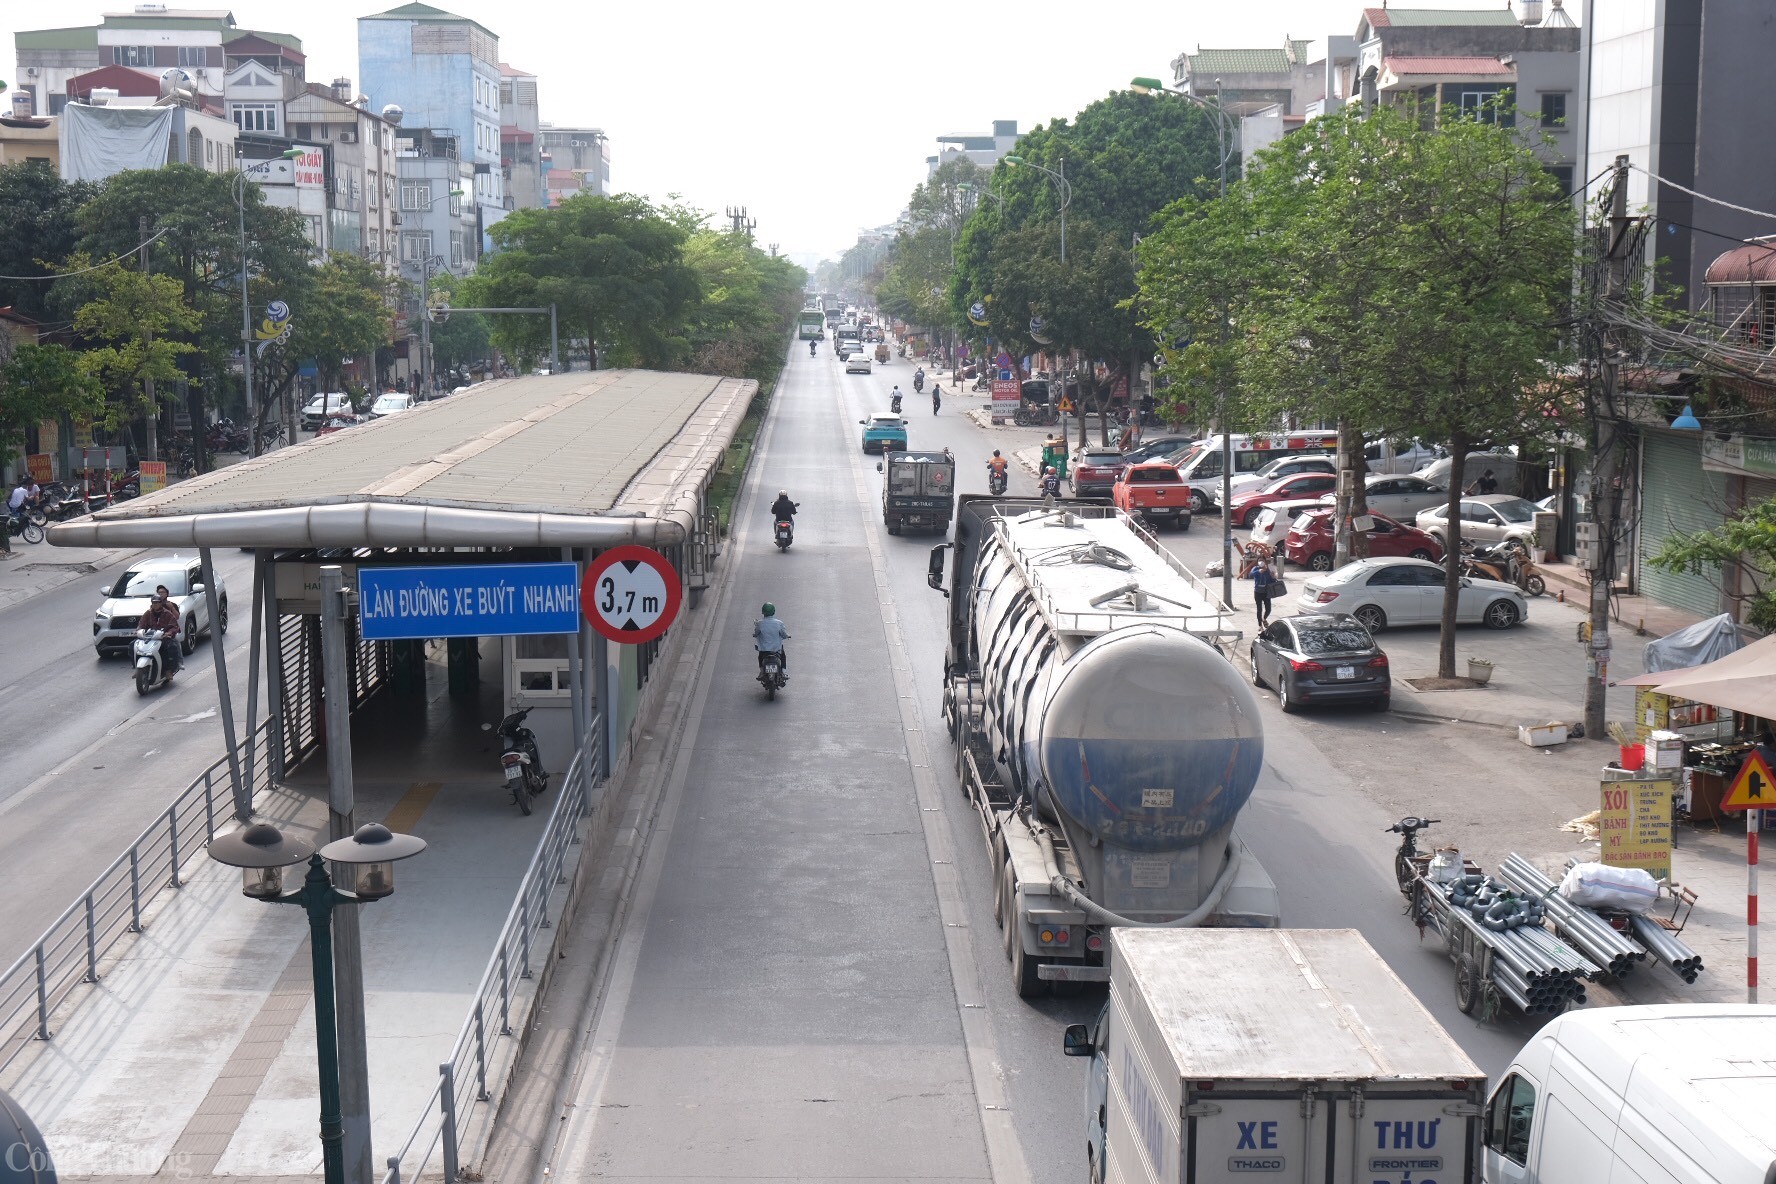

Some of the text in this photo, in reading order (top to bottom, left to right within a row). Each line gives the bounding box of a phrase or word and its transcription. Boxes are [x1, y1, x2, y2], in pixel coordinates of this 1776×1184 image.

[363, 579, 575, 618] LÀN ĐƯỜNG XE BUÝT NHANH
[642, 596, 659, 613] m
[1603, 784, 1628, 811] XÔI
[1604, 816, 1627, 830] BÁNH
[1605, 852, 1618, 863] ĐẶC
[1653, 851, 1668, 859] BAO
[1236, 1118, 1441, 1150] XE THƯ
[1233, 1160, 1439, 1169] THACO FRONTIER
